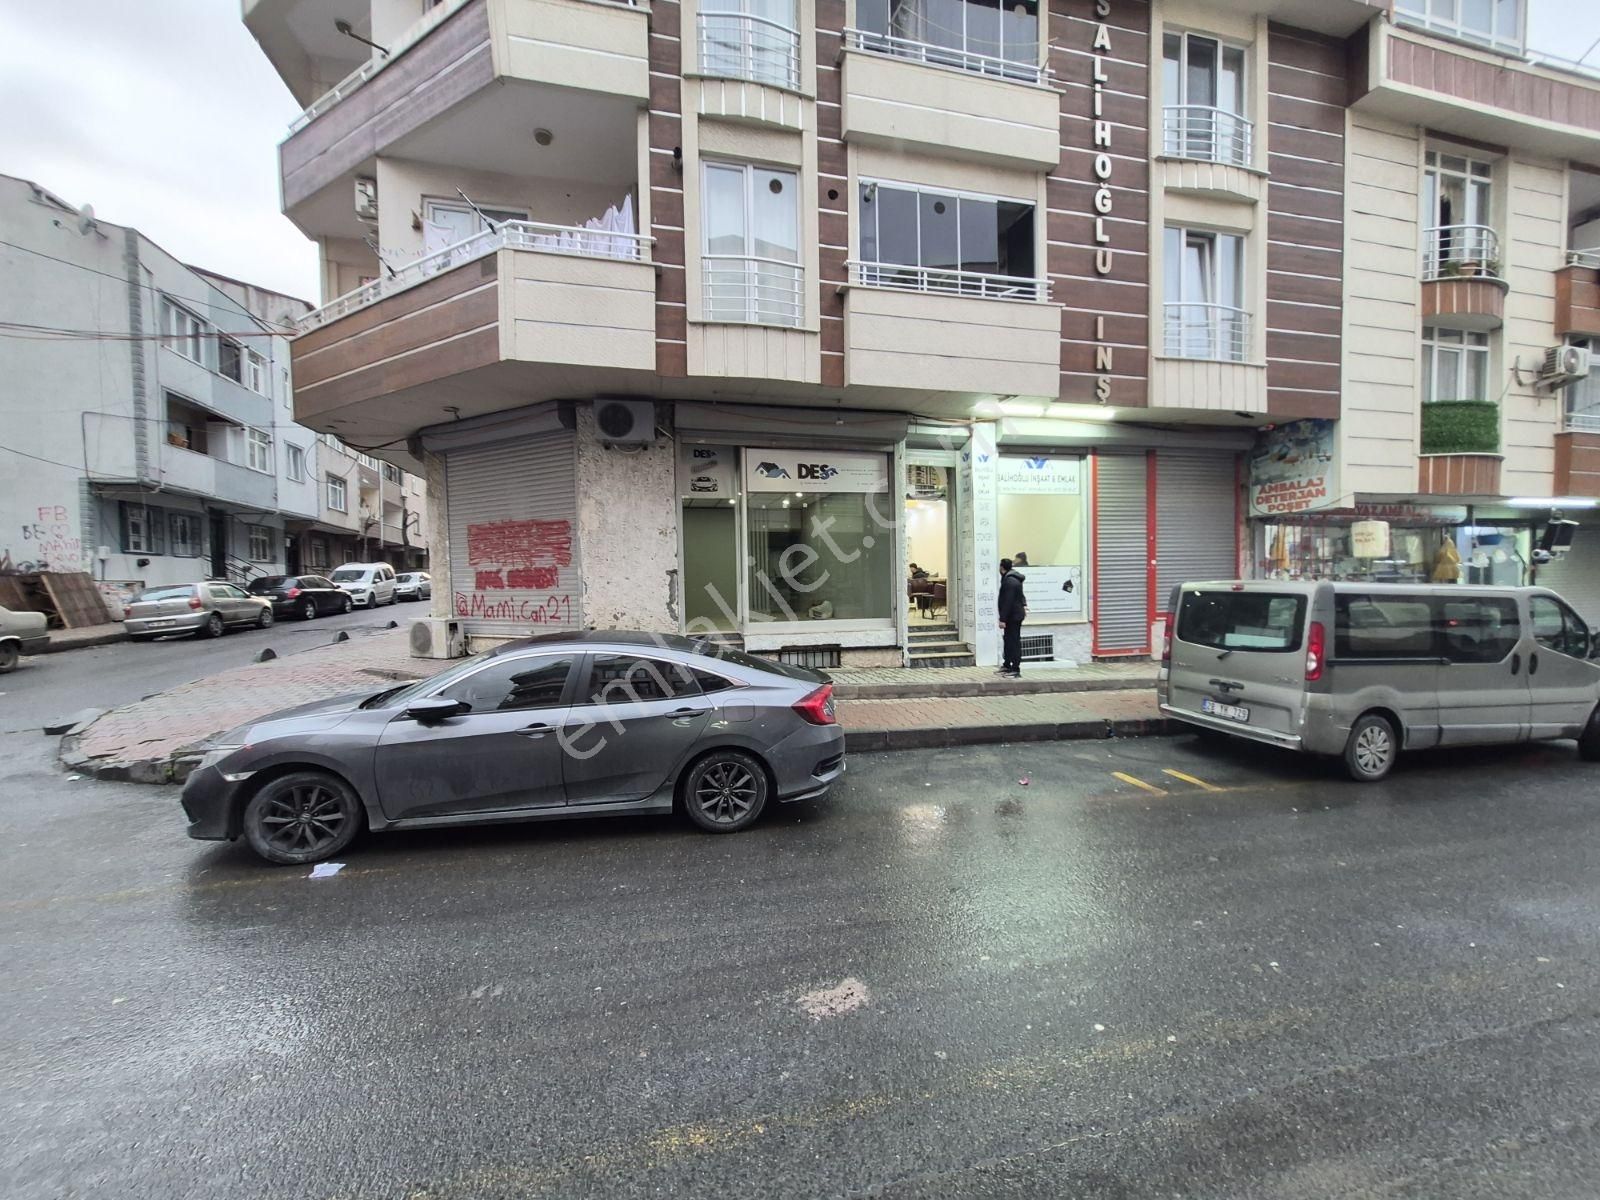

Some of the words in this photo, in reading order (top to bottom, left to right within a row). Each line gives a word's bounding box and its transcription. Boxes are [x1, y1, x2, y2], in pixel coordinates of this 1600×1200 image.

[1259, 477, 1324, 495] AMBALAJ
[1256, 487, 1326, 505] DETERJAN
[38, 505, 68, 521] FB
